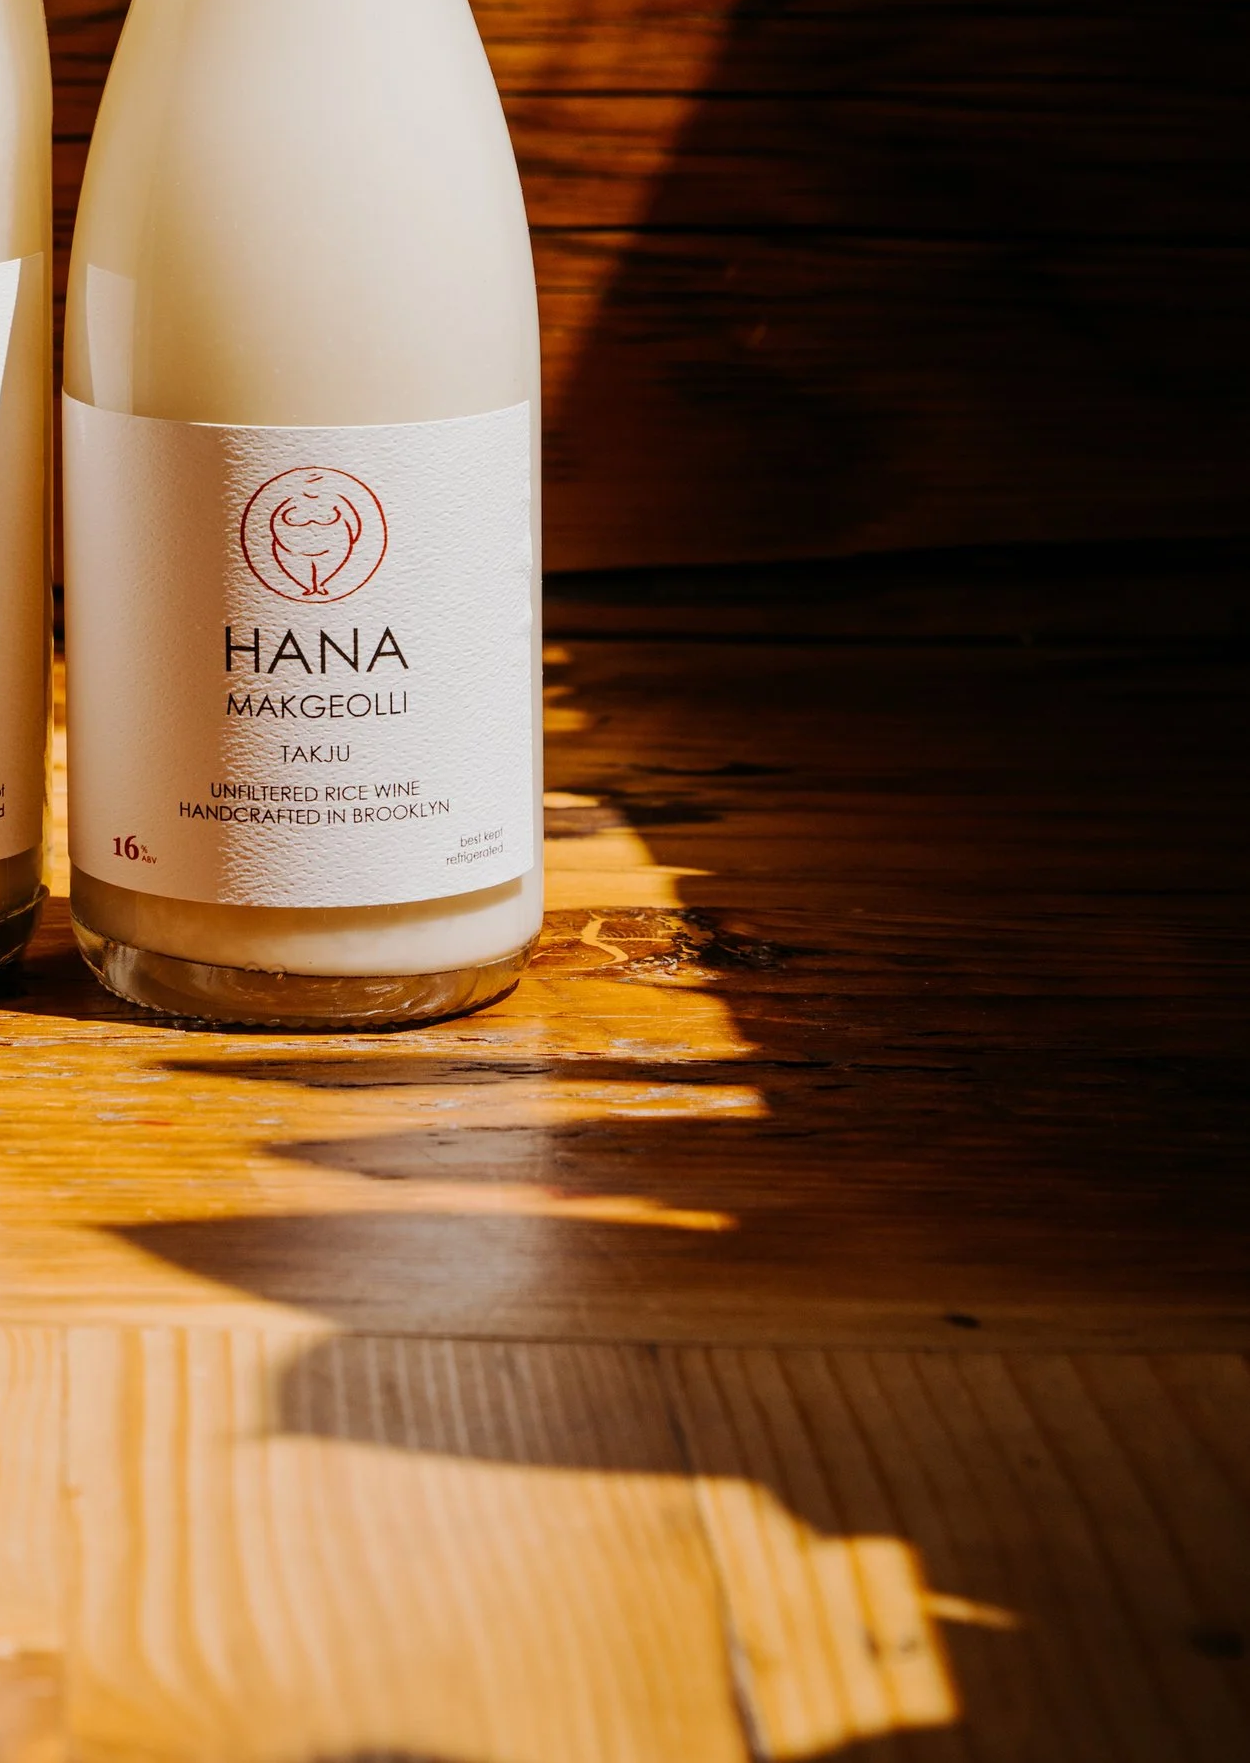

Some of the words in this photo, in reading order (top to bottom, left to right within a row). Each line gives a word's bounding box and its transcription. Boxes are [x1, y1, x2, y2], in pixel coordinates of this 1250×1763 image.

[225, 626, 409, 674] HANA
[226, 691, 407, 719] MAKGEOLLI
[280, 744, 350, 763] TAKJU
[210, 782, 319, 802] UNFILTERED
[325, 785, 368, 801] RICE
[374, 780, 420, 799] WINE
[179, 802, 321, 825] HANDCRAFTED
[327, 809, 346, 825] IN
[353, 799, 450, 824] BROOKLYN
[460, 833, 482, 848] best
[484, 826, 504, 843] kept
[141, 855, 157, 865] ABV
[446, 842, 504, 866] refrigerated
